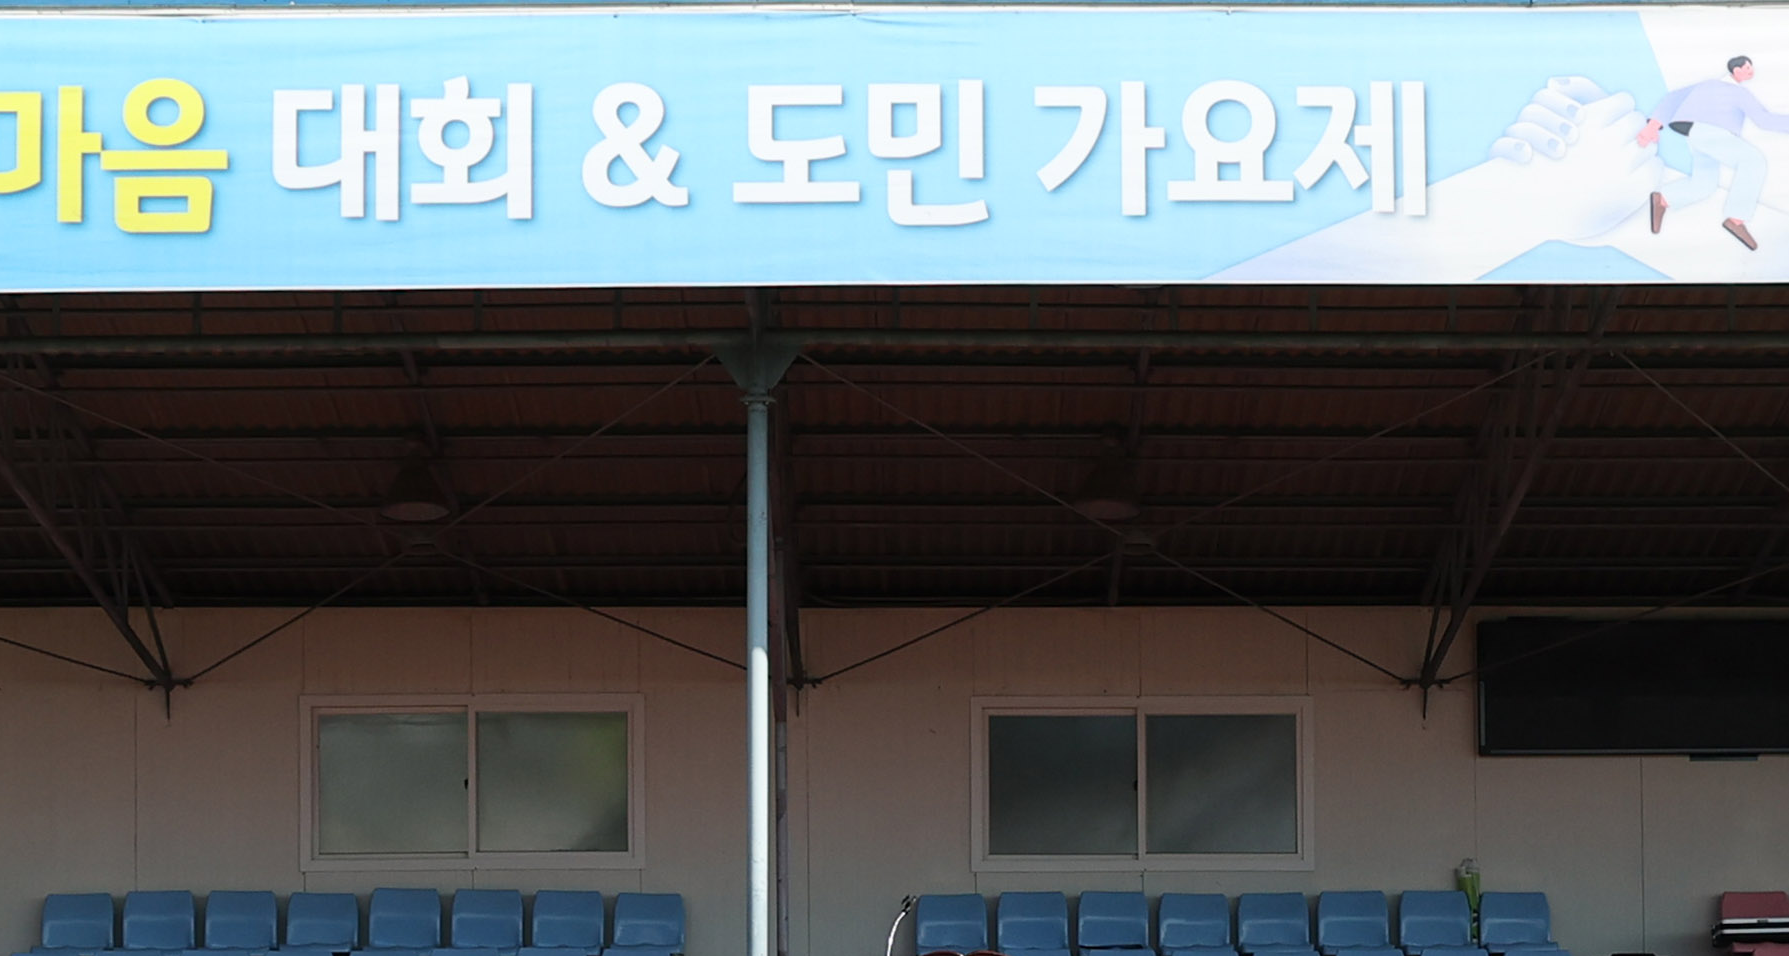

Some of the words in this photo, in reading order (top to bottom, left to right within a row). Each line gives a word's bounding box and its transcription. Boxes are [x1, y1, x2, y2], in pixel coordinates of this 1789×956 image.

[271, 76, 534, 222] 대회
[582, 80, 689, 209] &
[732, 80, 988, 228] 도민
[1034, 79, 1427, 218] 가요제
